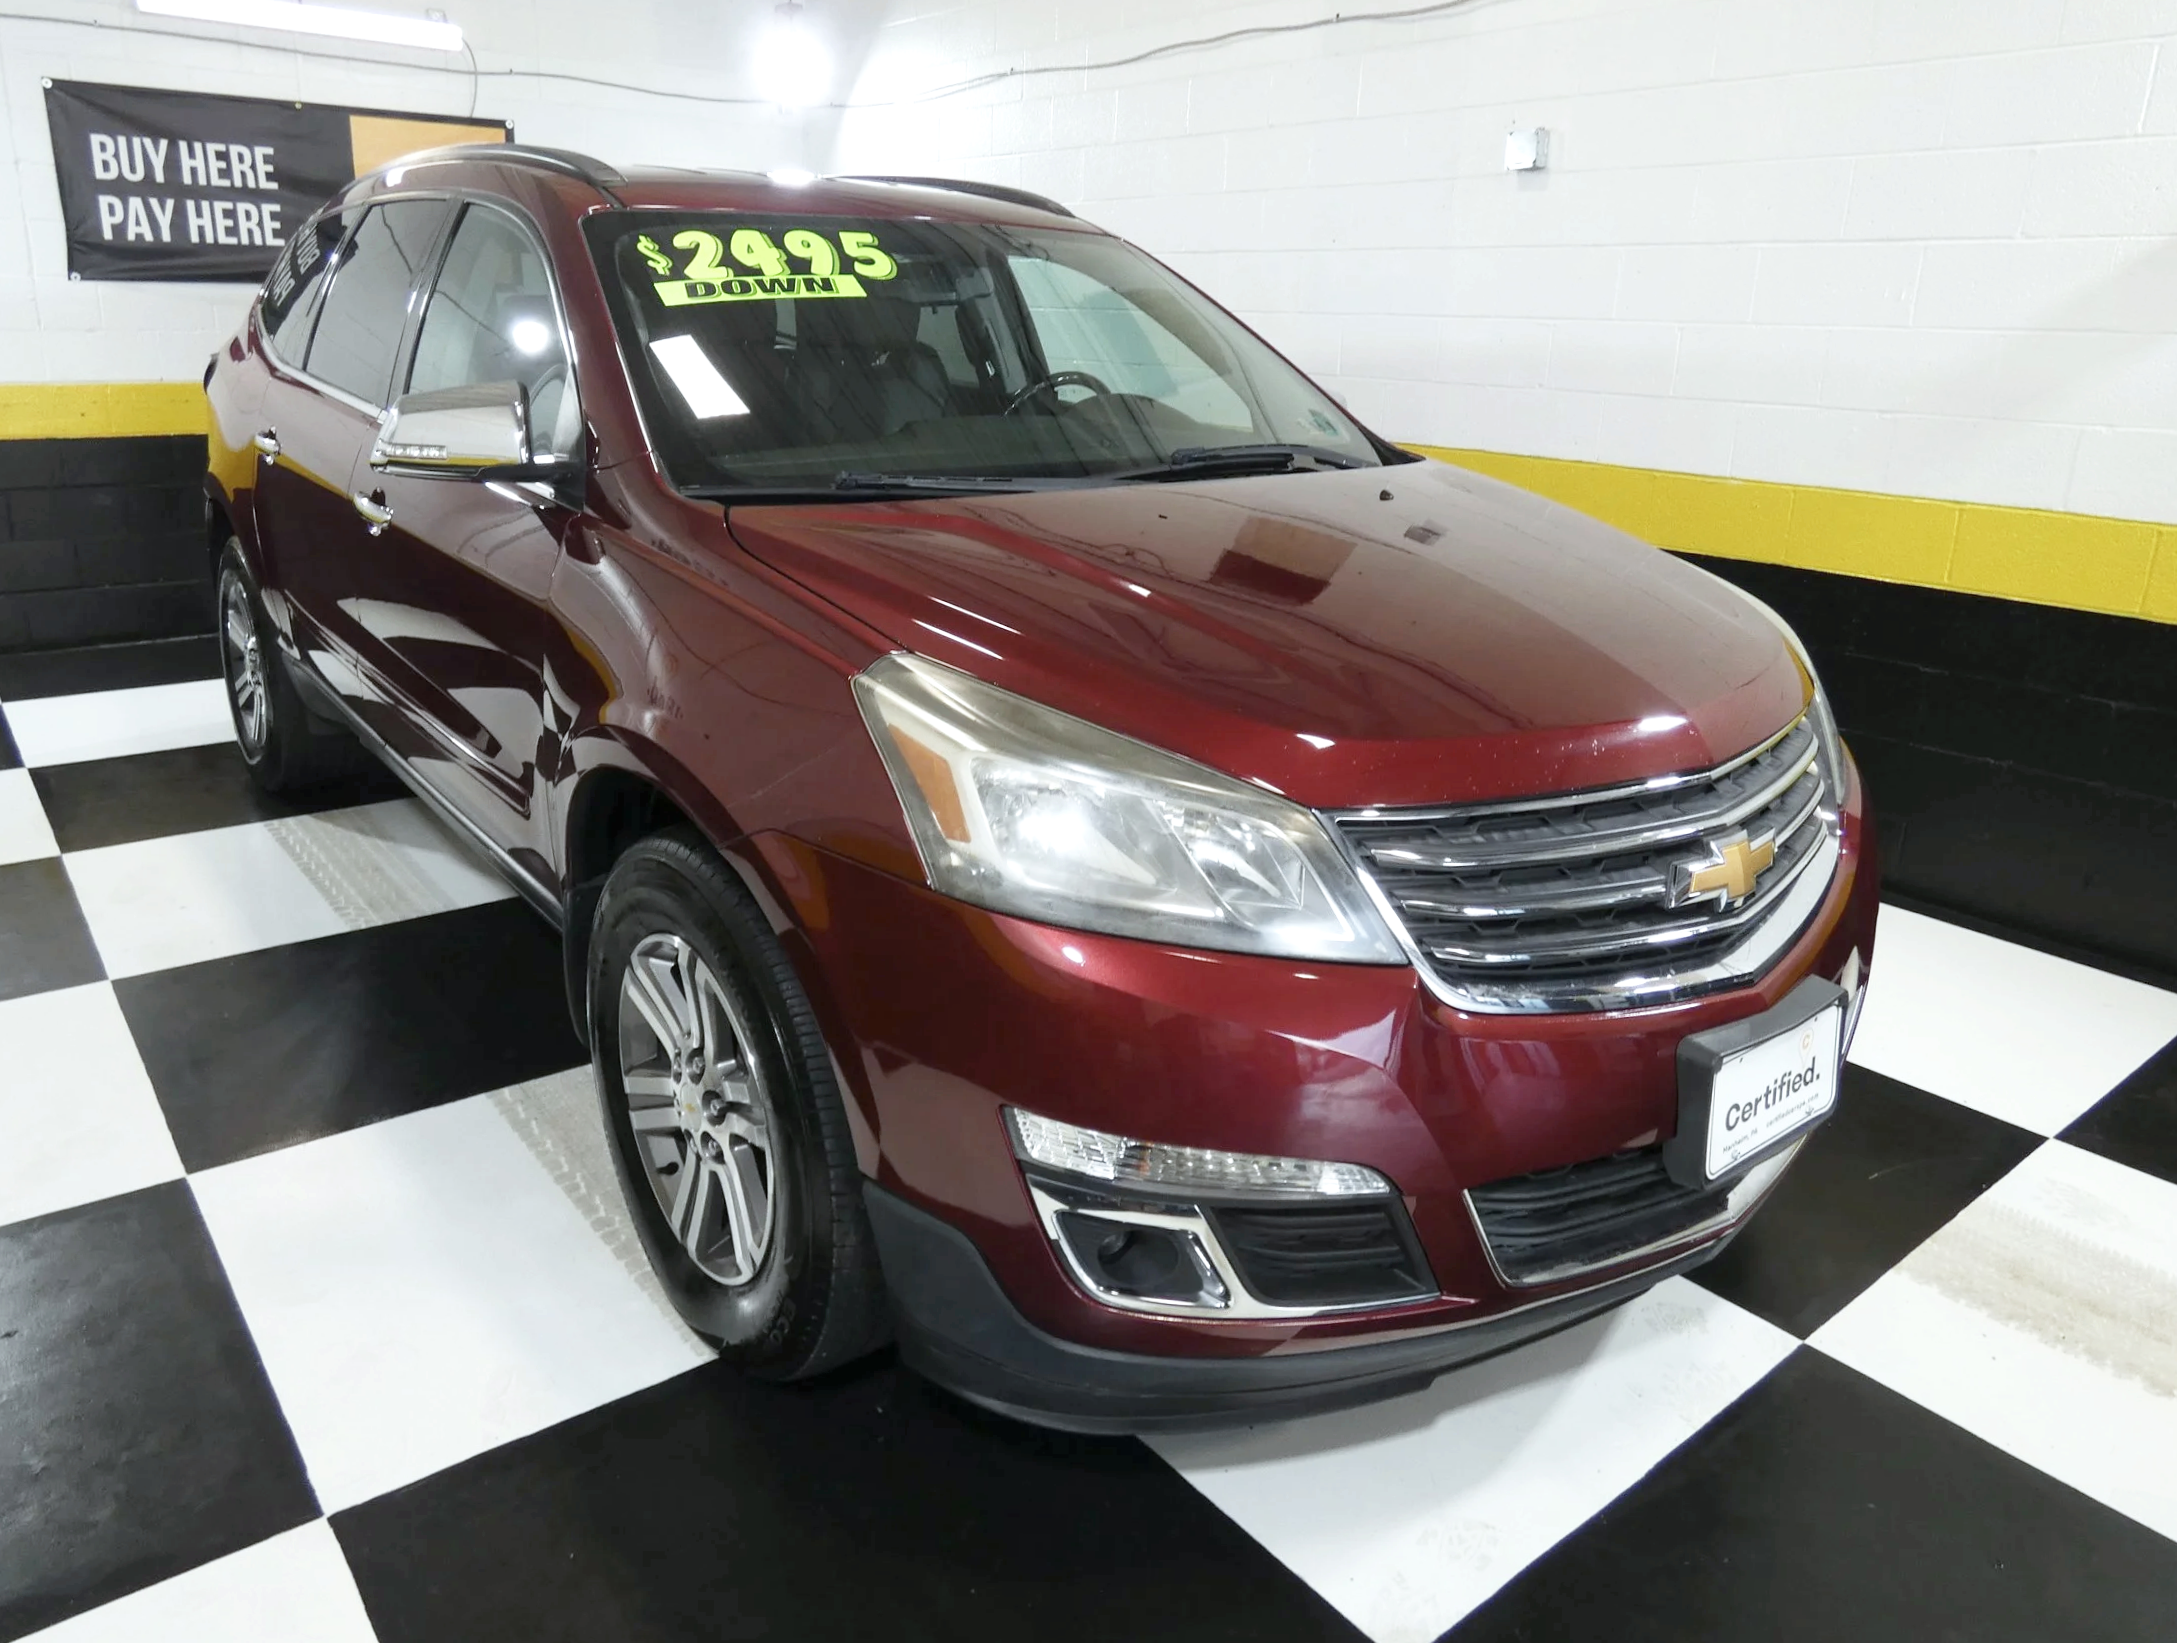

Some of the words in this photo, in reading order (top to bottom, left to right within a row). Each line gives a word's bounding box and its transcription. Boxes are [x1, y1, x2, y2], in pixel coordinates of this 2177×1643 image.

[89, 133, 168, 183] BUY
[178, 140, 278, 190] HERE
[98, 194, 174, 243] PAY
[186, 199, 285, 247] HERE
[637, 229, 897, 280] $2495
[684, 277, 840, 299] DOWN
[1725, 1056, 1820, 1132] Certified.
